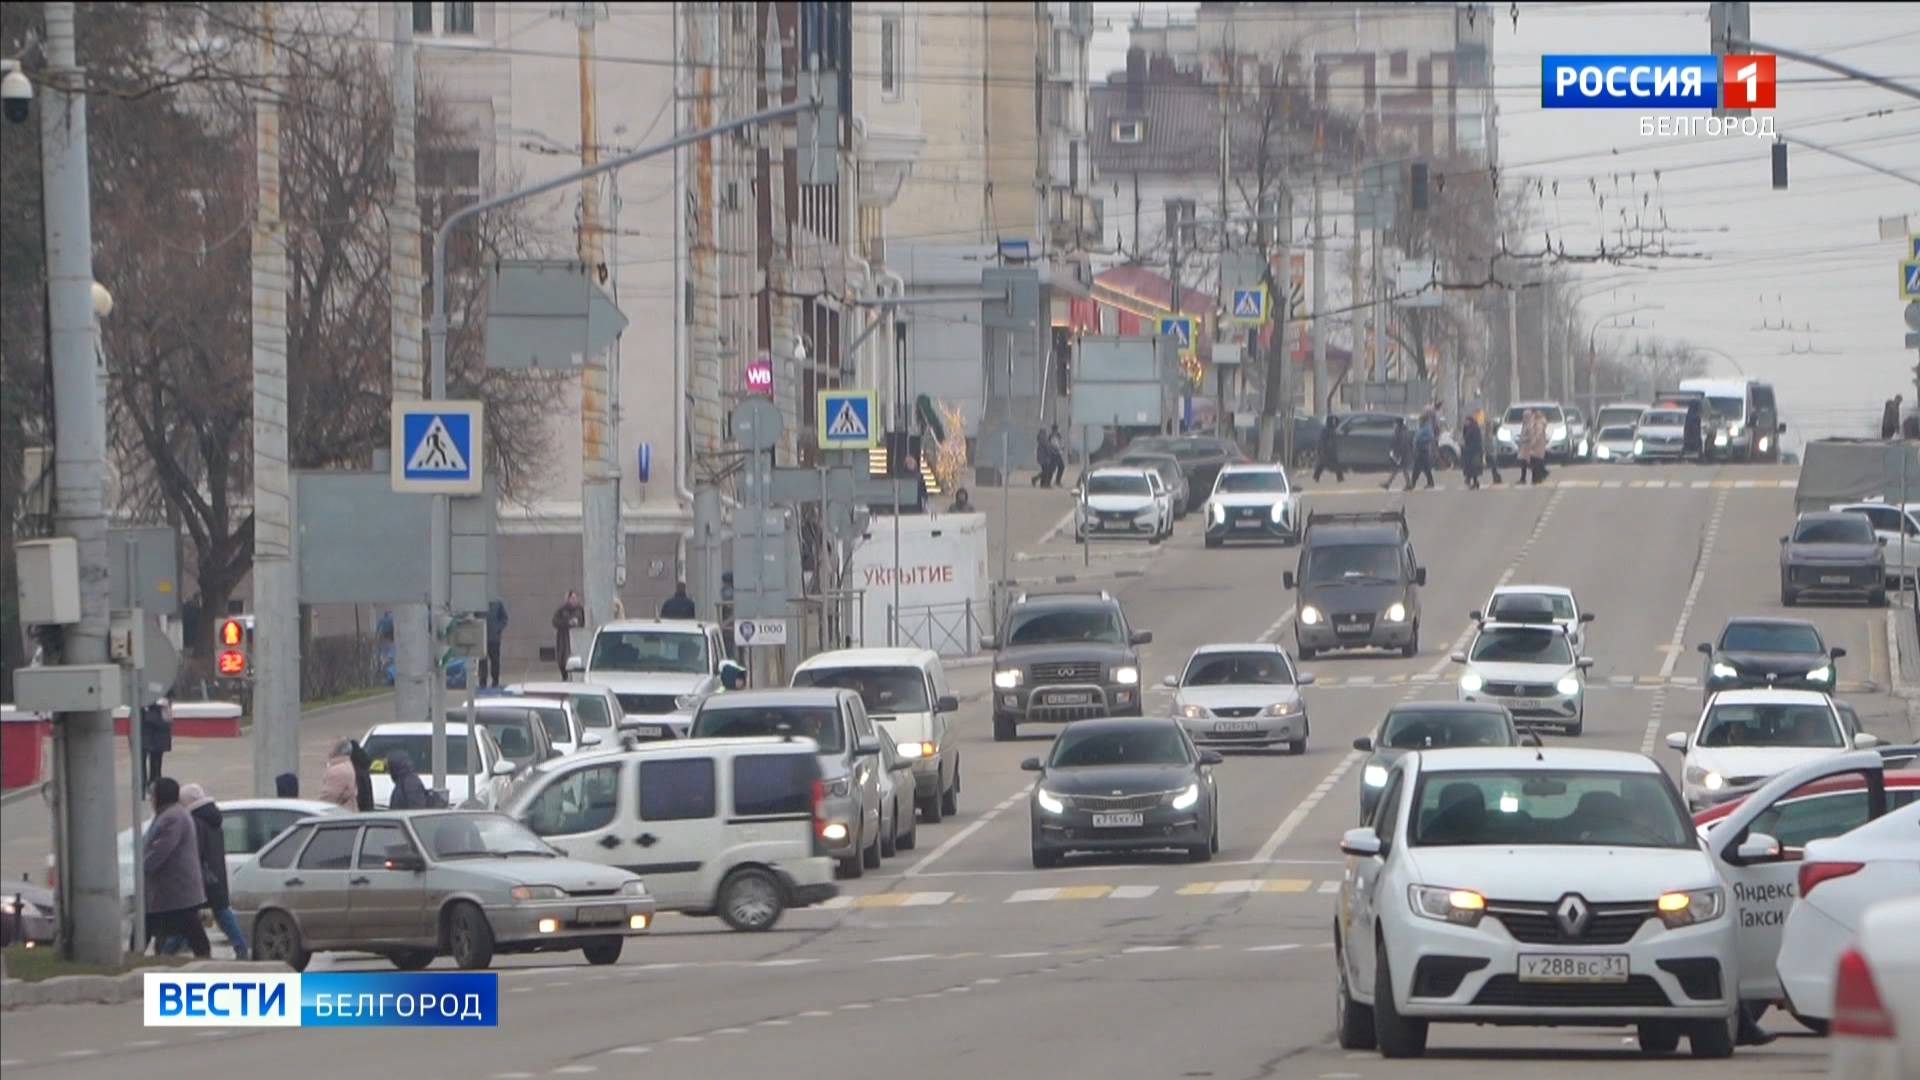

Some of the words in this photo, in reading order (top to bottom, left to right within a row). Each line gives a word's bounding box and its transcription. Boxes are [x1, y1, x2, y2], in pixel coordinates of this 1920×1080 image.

[748, 368, 771, 385] WB
[759, 623, 783, 634] 1000
[221, 654, 242, 672] 32
[1733, 882, 1795, 903] Яндекс
[1739, 907, 1784, 928] Такси
